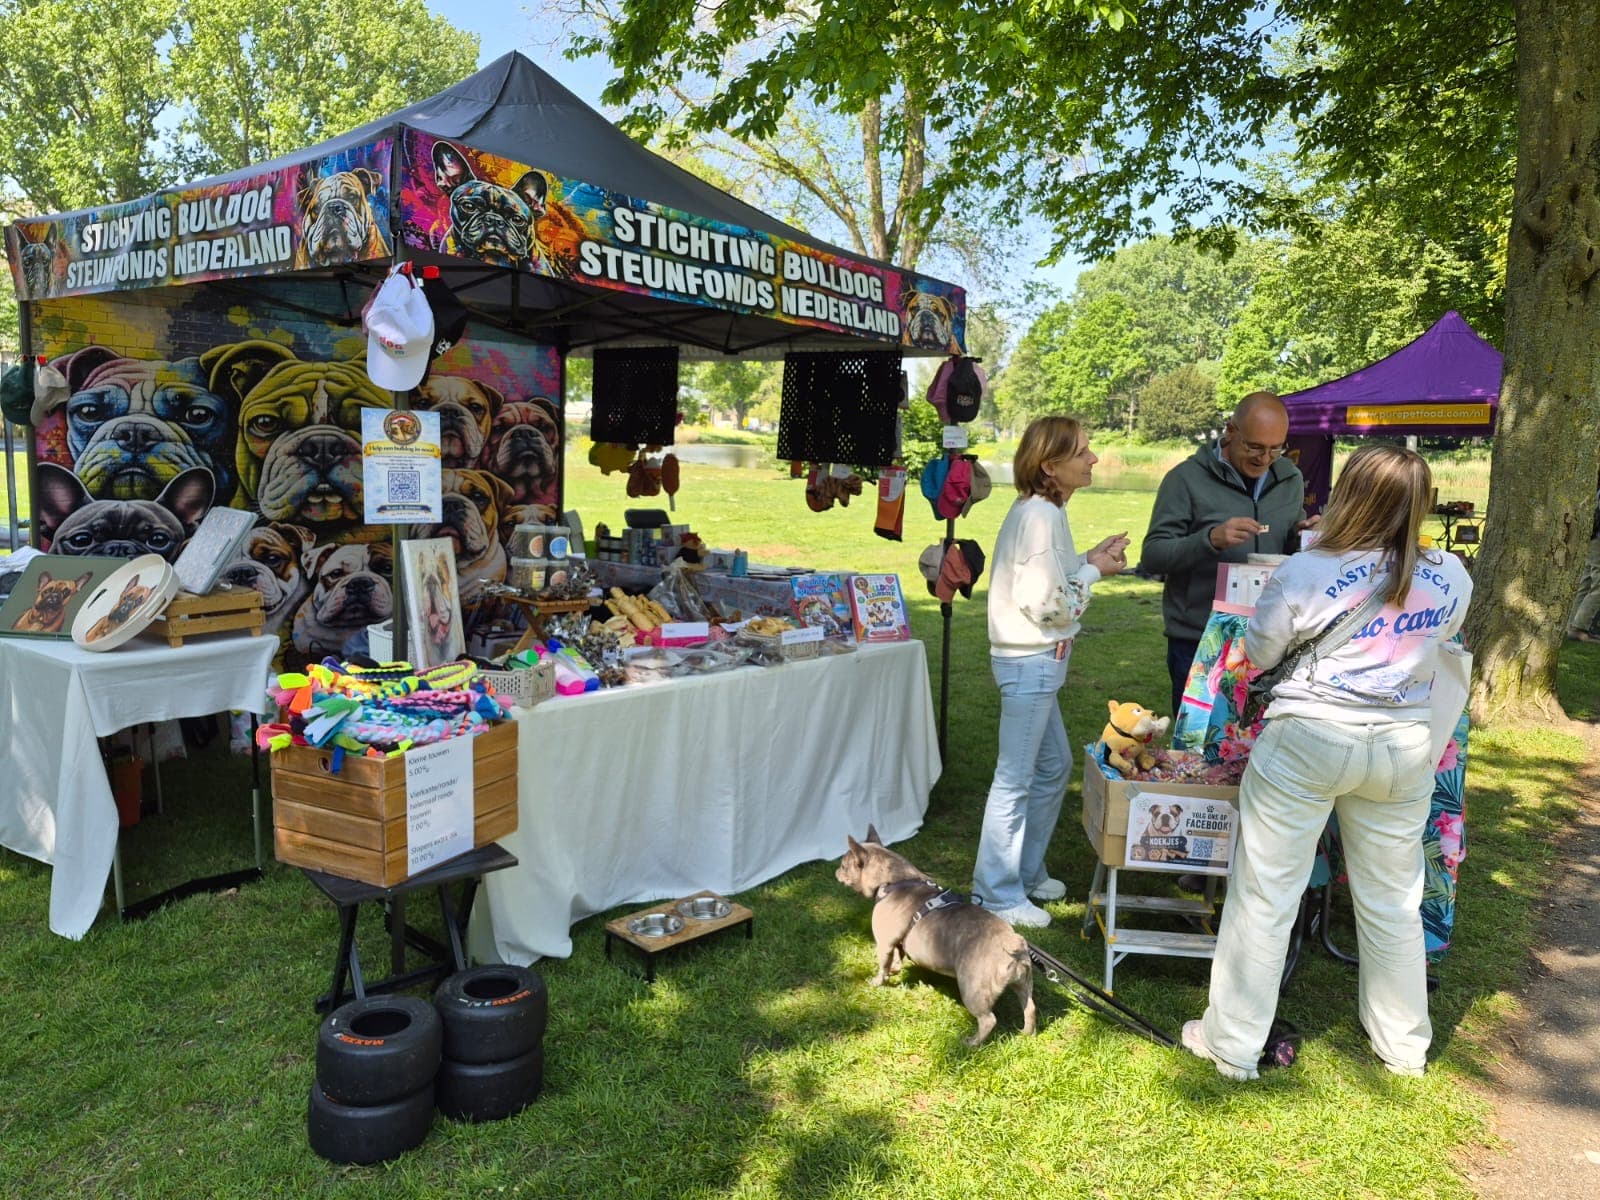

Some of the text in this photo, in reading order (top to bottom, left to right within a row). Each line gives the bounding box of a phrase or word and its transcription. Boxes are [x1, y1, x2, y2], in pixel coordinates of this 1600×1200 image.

[81, 185, 273, 253] STICHTING BULLDOG
[66, 225, 292, 289] STEUNFONDS NEDERLAND
[614, 207, 883, 303] STICHTING BULLDOG
[580, 242, 899, 337] STEUNFONDS NEDERLAND
[1325, 560, 1451, 600] PASTA FESCA
[1393, 597, 1459, 634] caro!
[1186, 818, 1232, 831] FACEBOOK!
[1192, 811, 1207, 820] VOLG
[1149, 837, 1179, 846] KOEKJES
